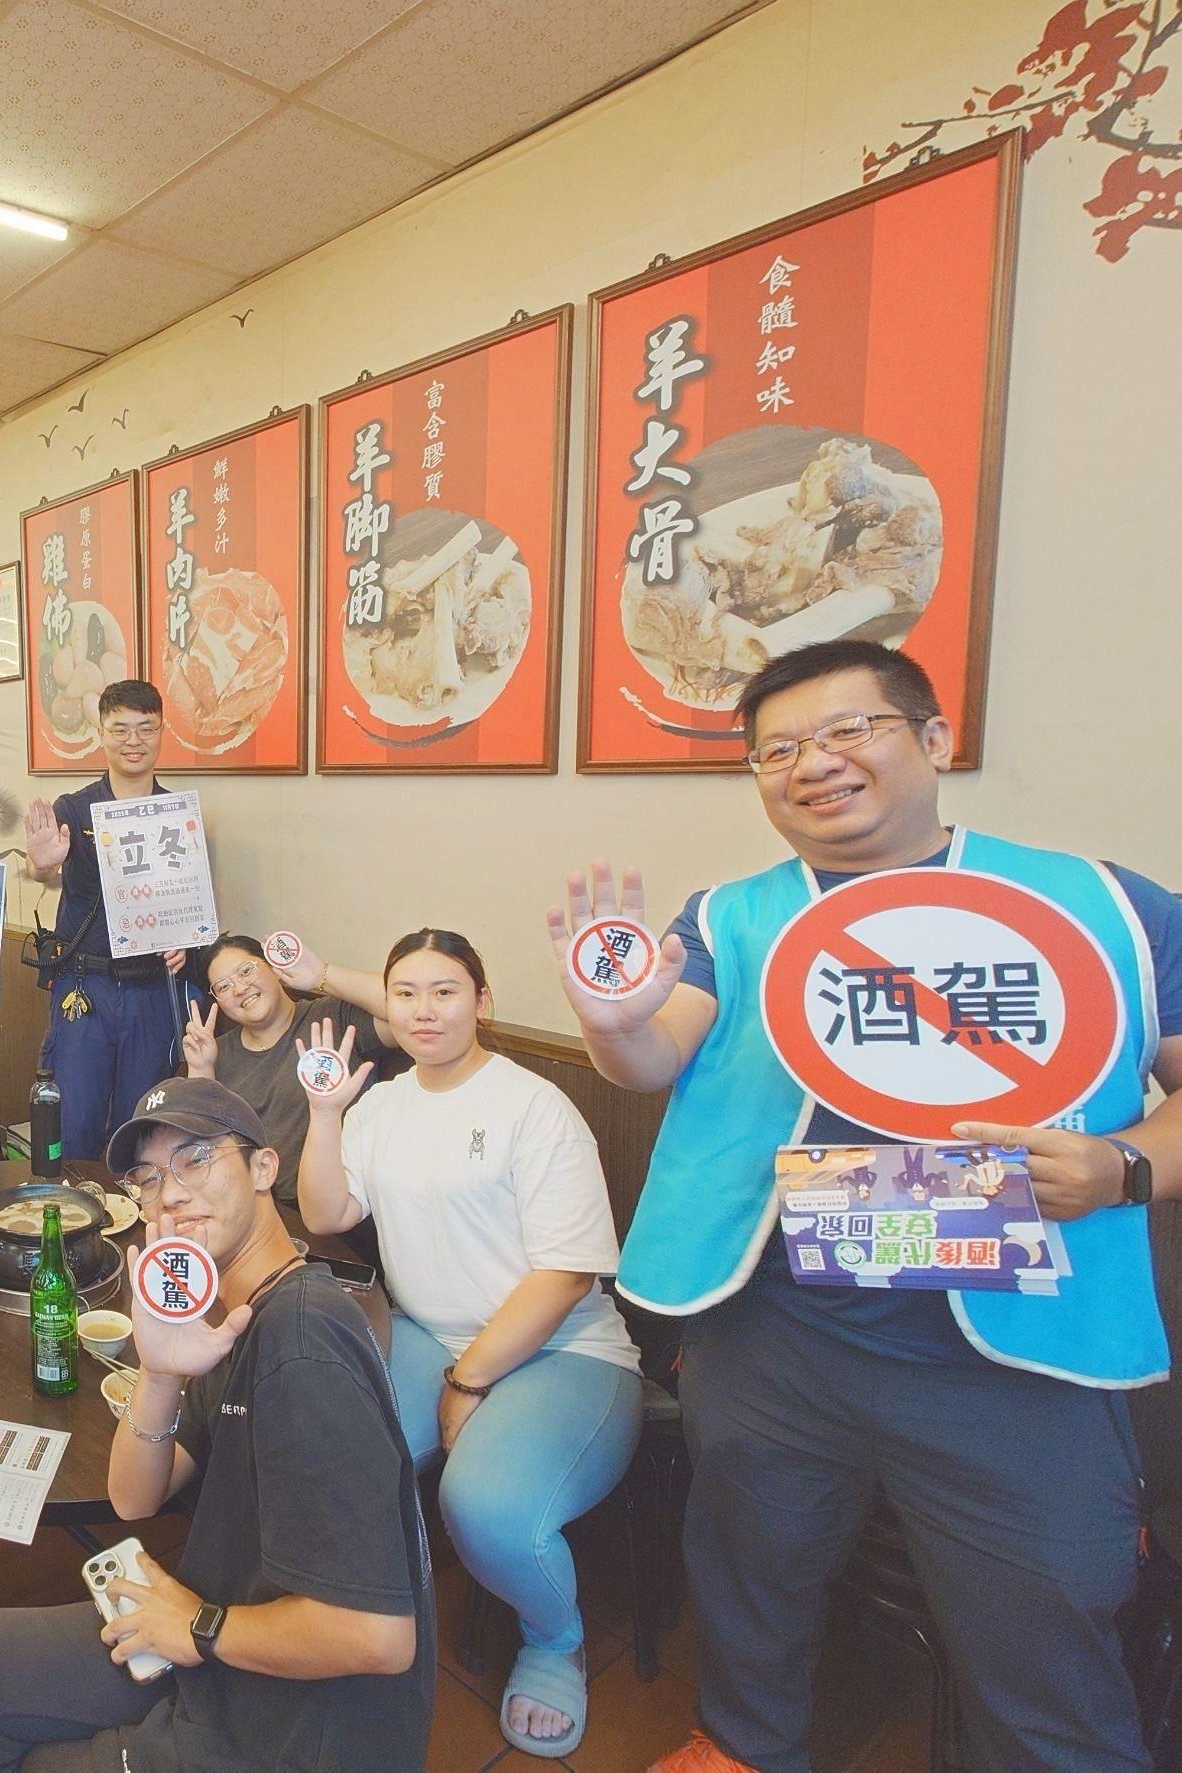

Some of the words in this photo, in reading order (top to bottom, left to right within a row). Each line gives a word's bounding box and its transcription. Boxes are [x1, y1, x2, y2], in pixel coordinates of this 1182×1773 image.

[756, 254, 800, 414] 食髓知味
[421, 380, 447, 502] 富含膠質
[626, 320, 705, 582] 羊大骨
[79, 505, 93, 590] 膠原蛋白
[213, 457, 231, 555] 鮮嫩多汁
[41, 533, 72, 646] 雞佛
[166, 488, 195, 649] 羊肉片
[119, 825, 187, 876] 立冬
[591, 927, 636, 987] 酒駕
[818, 961, 1048, 1047] 酒駕
[817, 1211, 936, 1239] 安全回家
[873, 1238, 1000, 1267] 酒後代駕
[44, 1304, 58, 1314] 18
[160, 1250, 190, 1311] 酒駕
